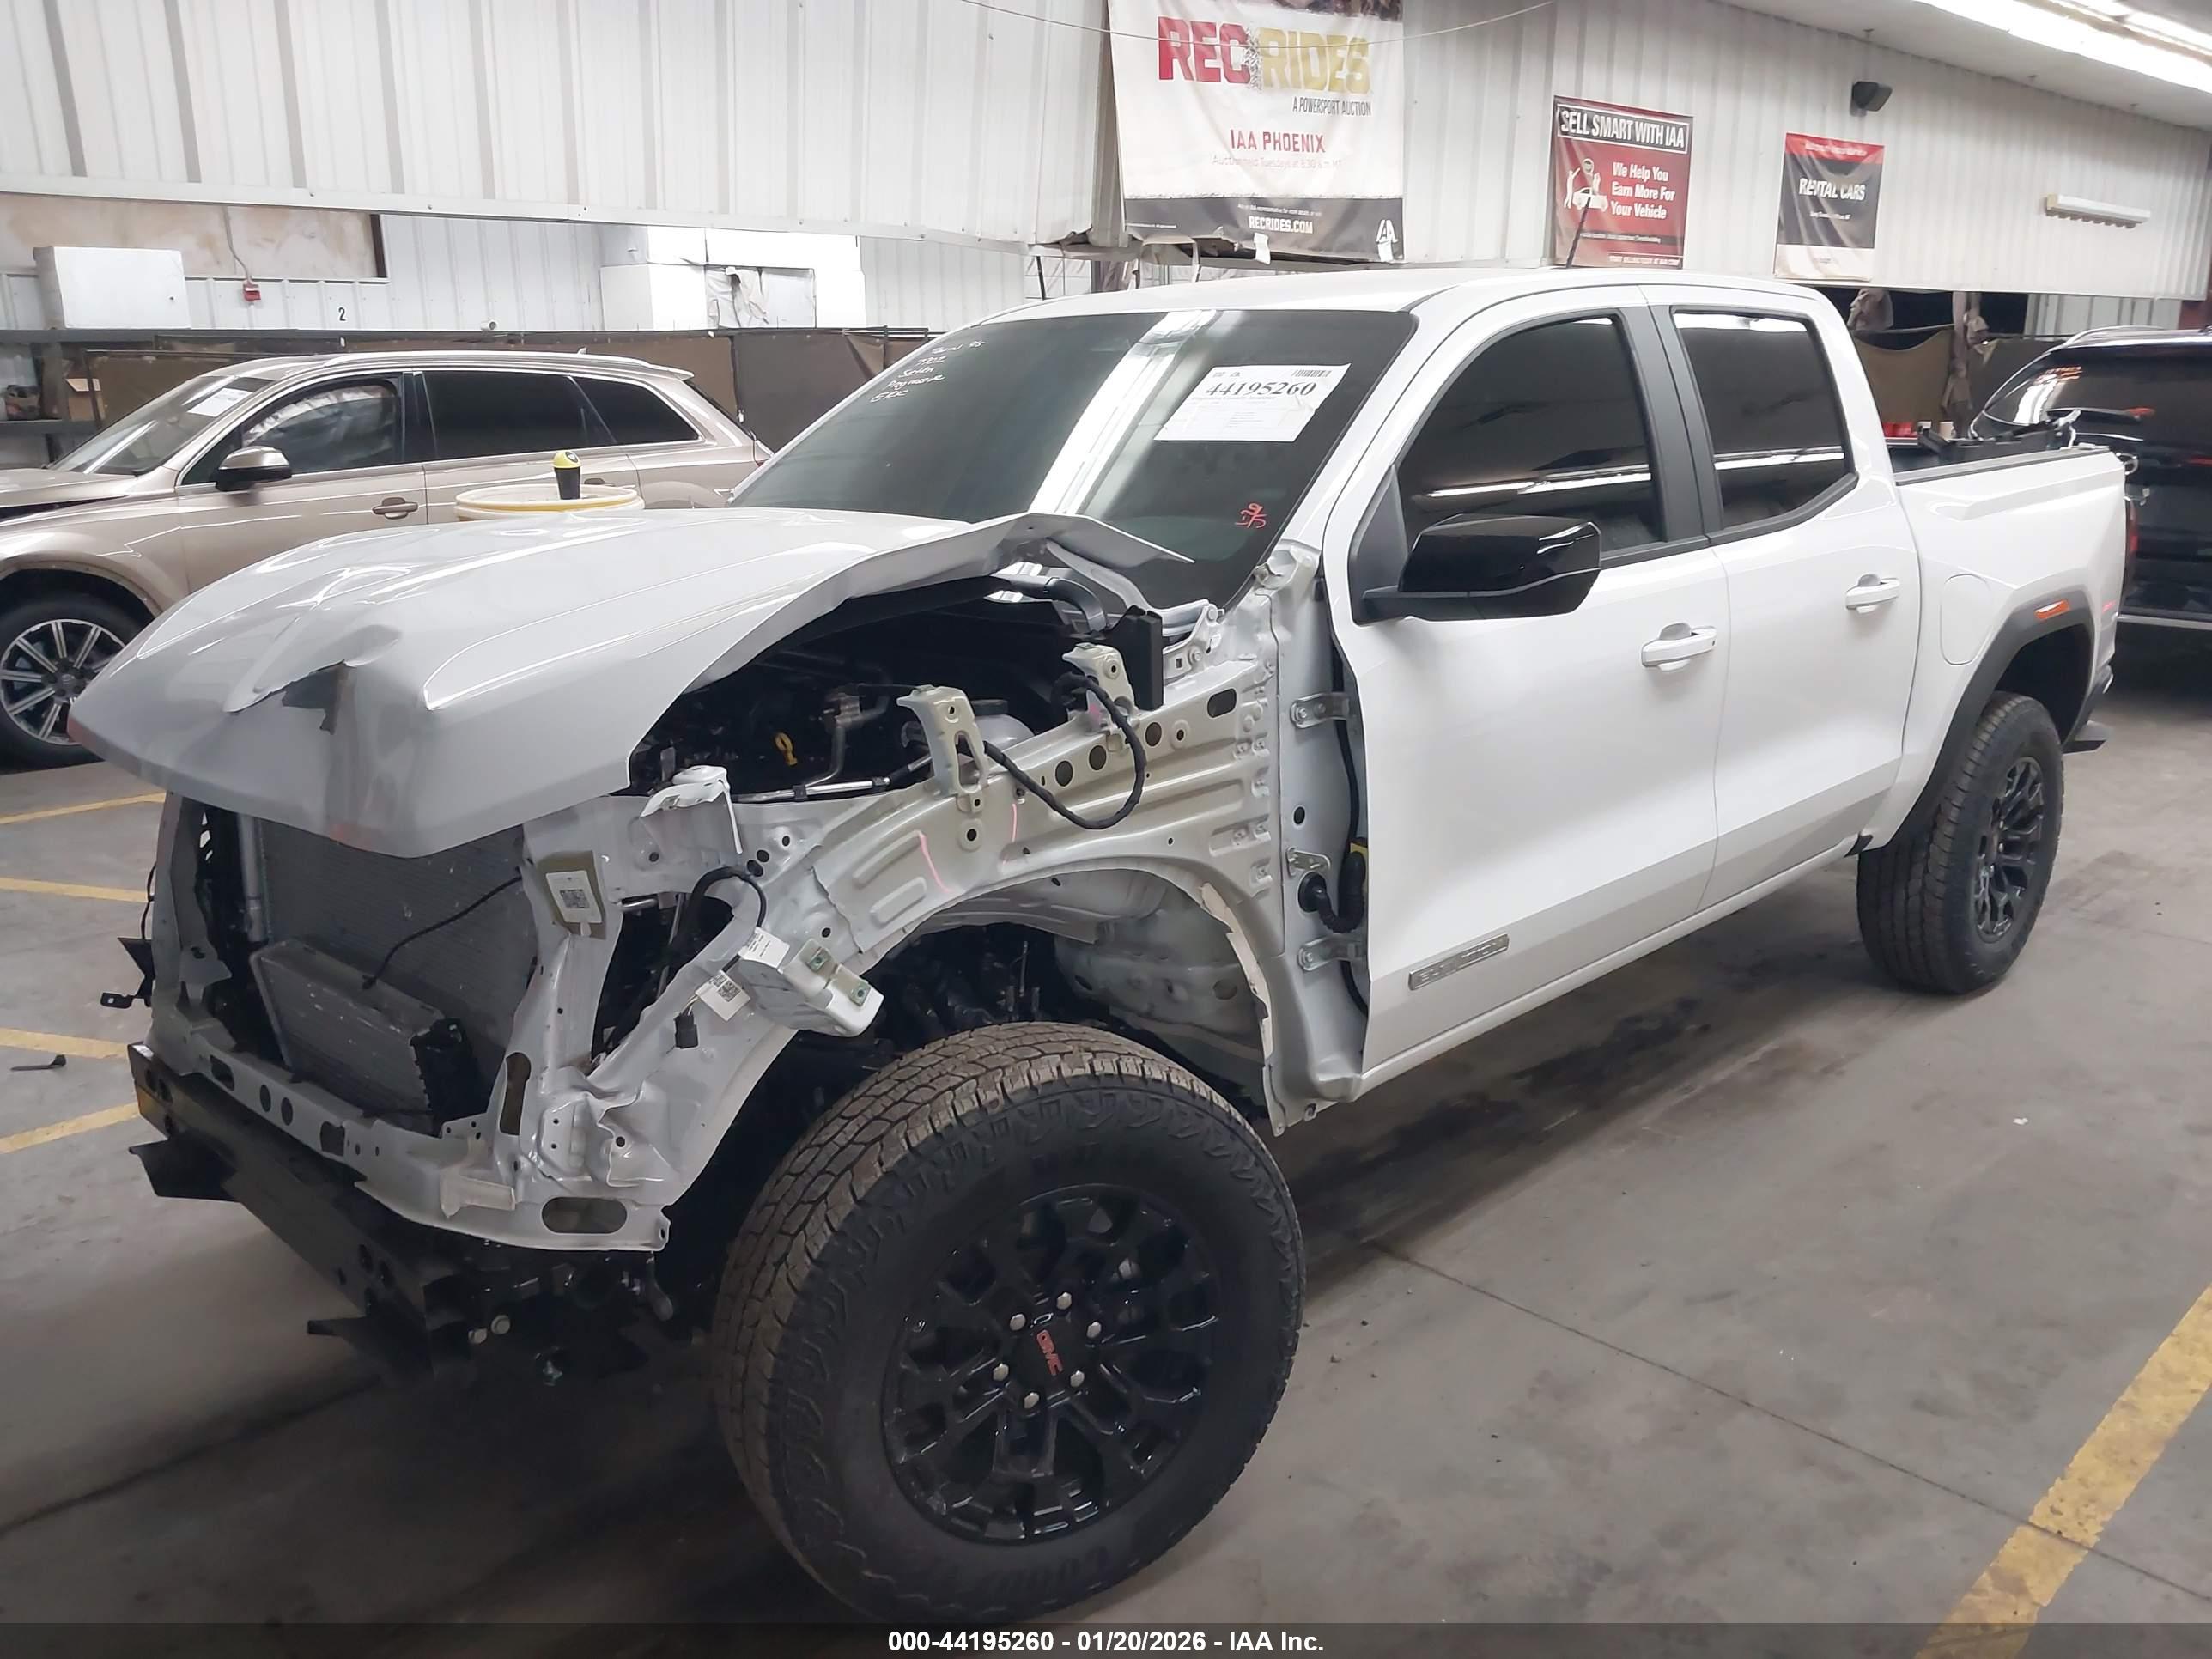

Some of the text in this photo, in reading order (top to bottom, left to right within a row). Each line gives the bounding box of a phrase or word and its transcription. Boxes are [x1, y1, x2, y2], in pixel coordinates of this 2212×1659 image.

[1259, 27, 1372, 94] RIDES
[1292, 96, 1371, 117] A POWERSPORT AUCTION
[1561, 110, 1685, 149] SELL SMART WITH IAA
[1231, 129, 1326, 154] IAA PHOENIX
[1613, 161, 1669, 183] We Help You
[1611, 181, 1676, 202] Earn More For
[1839, 184, 1866, 201] CARS
[1610, 200, 1668, 220] Your Vehicle
[1248, 215, 1314, 234] RECRIDES.COM
[338, 307, 347, 322] 2
[1205, 381, 1318, 396] 44195260
